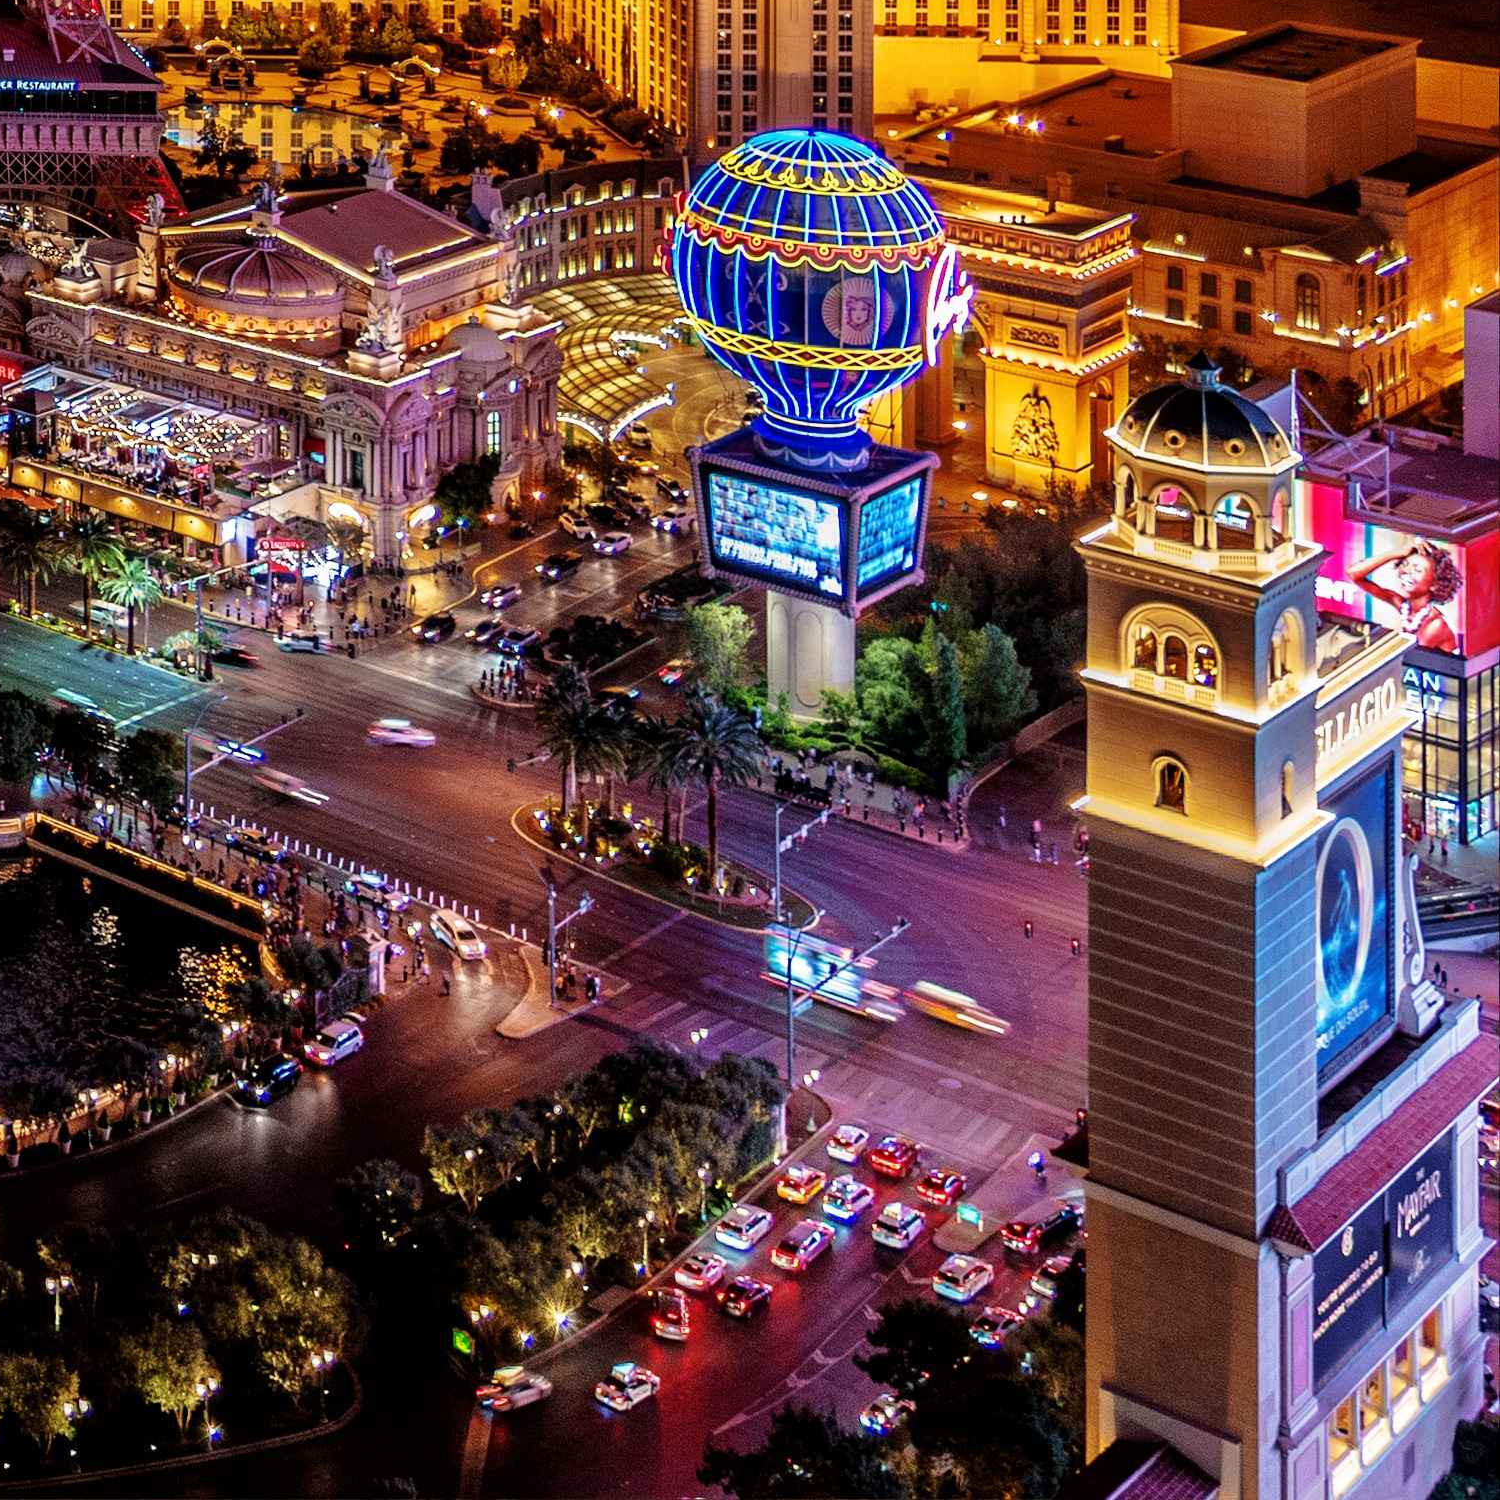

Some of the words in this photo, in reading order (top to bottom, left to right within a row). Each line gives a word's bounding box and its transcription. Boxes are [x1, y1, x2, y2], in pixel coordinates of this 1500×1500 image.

[17, 80, 76, 90] RESTAURANT
[1315, 677, 1396, 753] ELLAGIO
[1397, 1170, 1441, 1238] MAYFAIR
